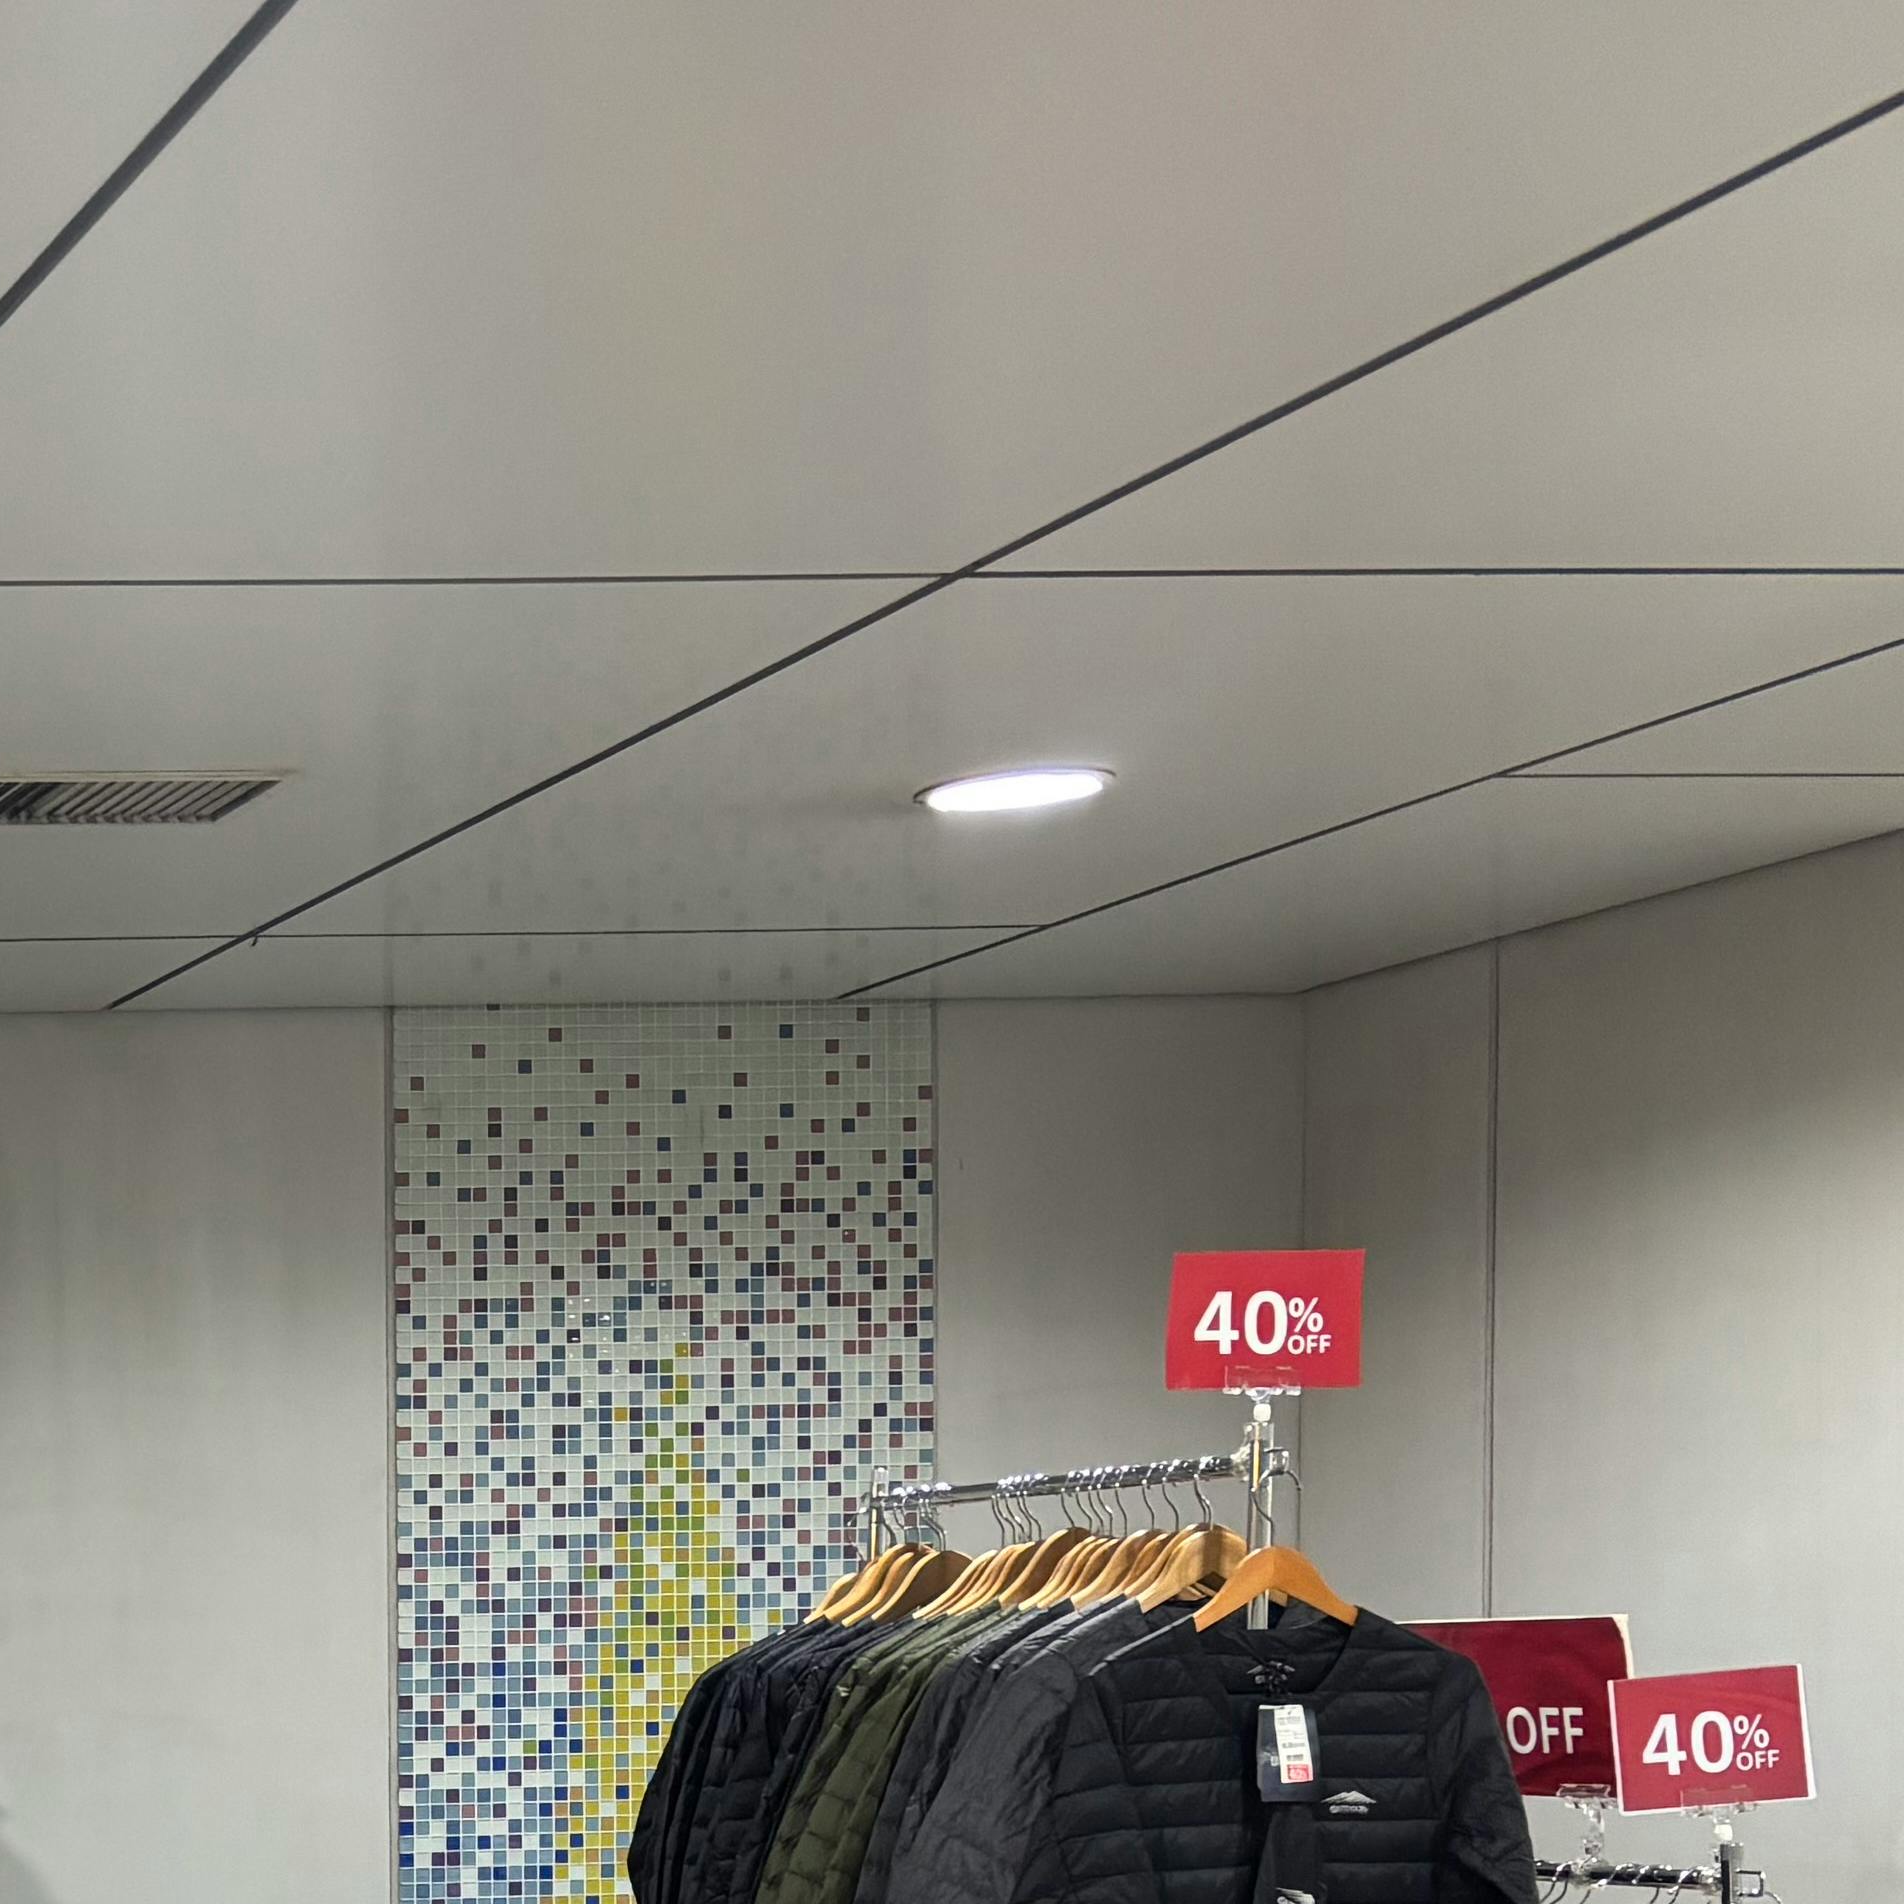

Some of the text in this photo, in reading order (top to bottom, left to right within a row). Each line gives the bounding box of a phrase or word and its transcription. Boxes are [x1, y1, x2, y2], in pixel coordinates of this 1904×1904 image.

[1194, 1290, 1332, 1355] 40% OFF
[1641, 1710, 1780, 1776] 40% OFF
